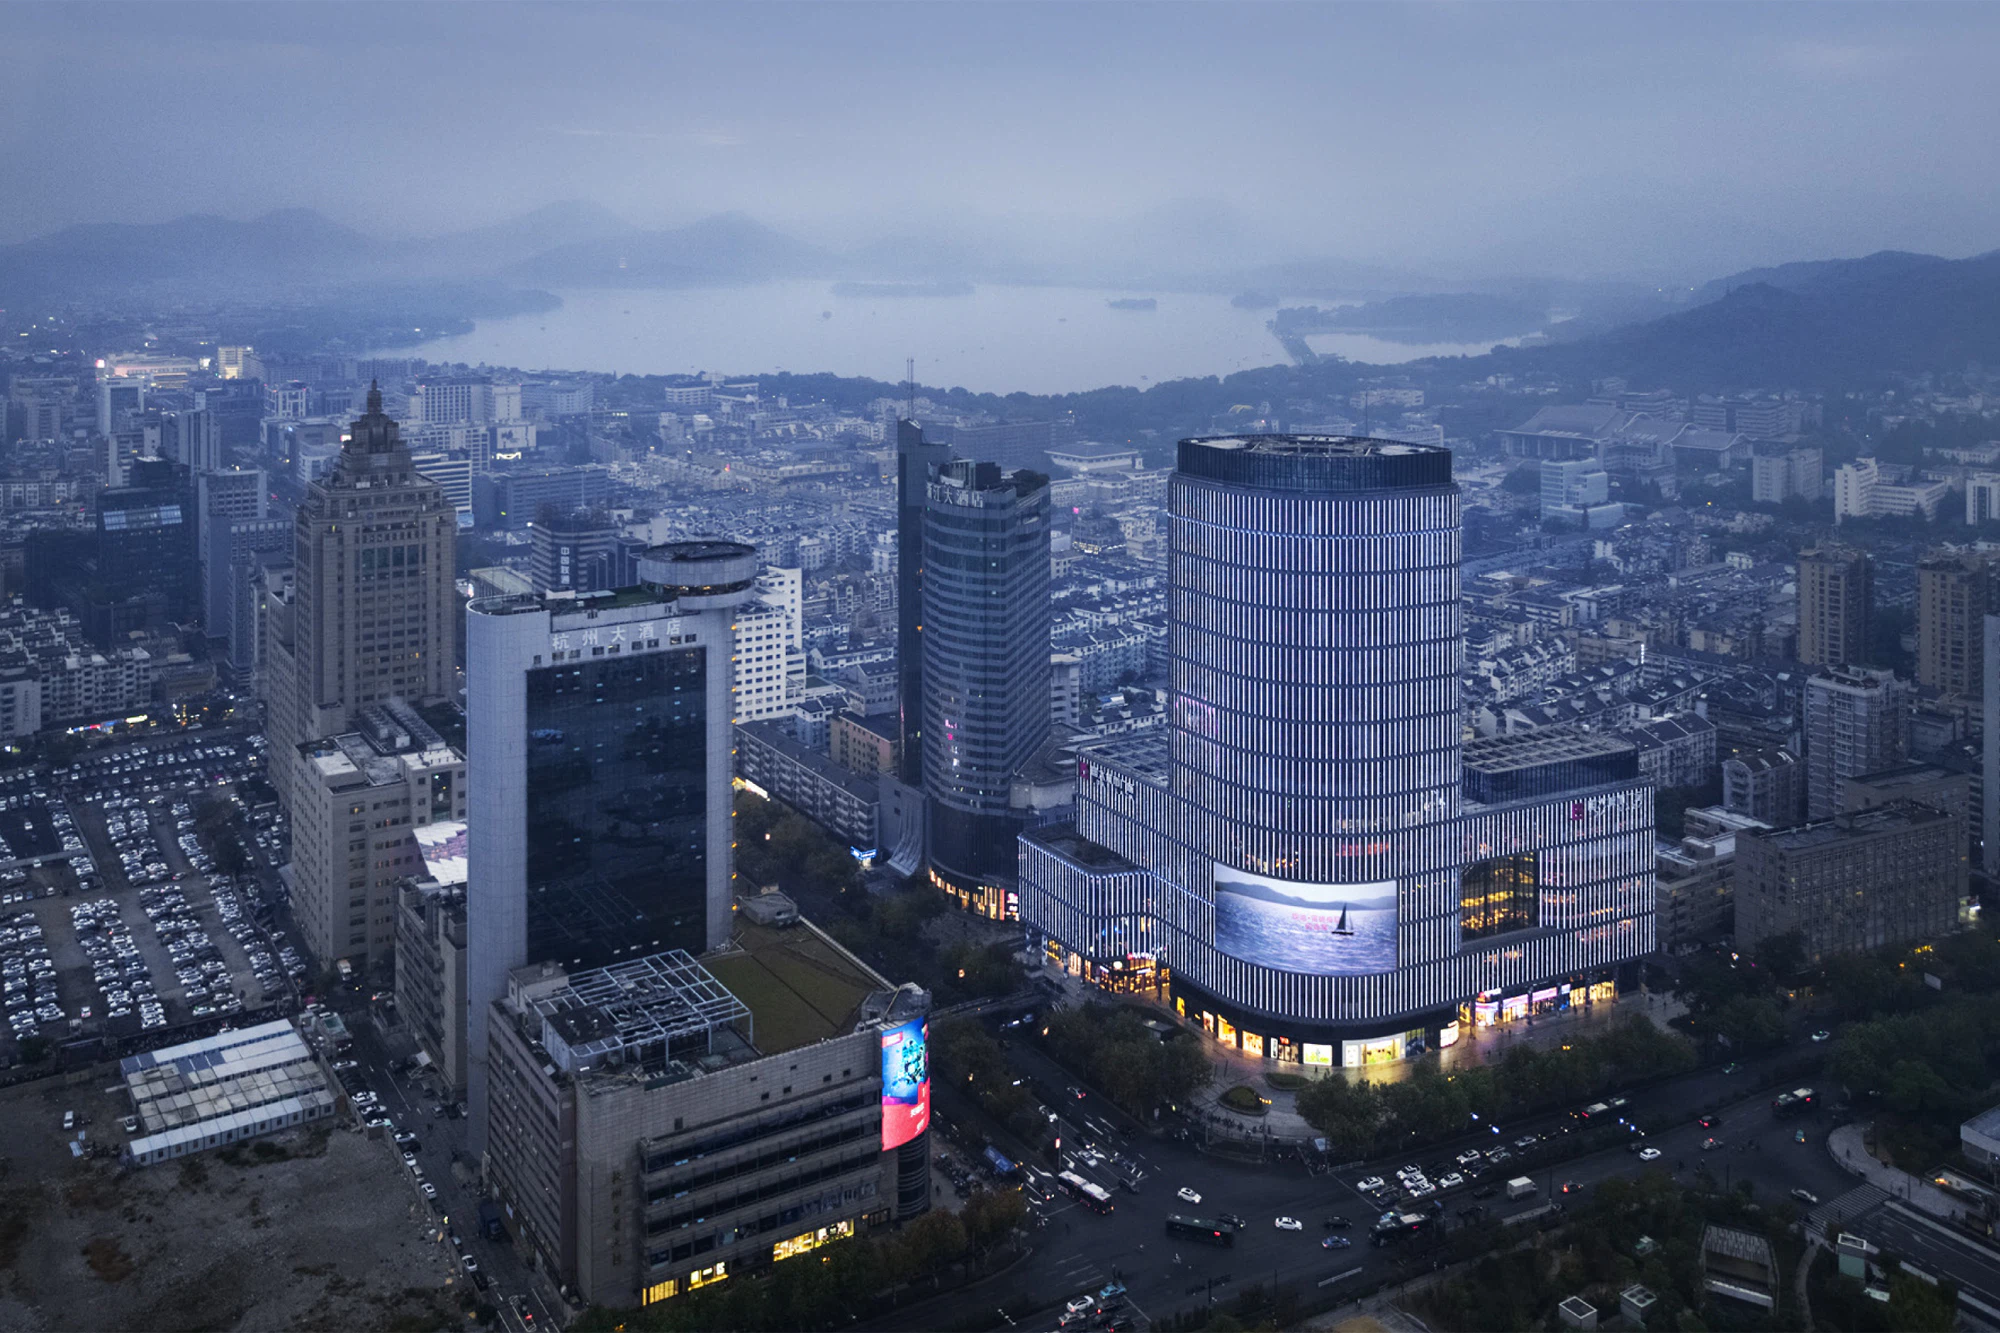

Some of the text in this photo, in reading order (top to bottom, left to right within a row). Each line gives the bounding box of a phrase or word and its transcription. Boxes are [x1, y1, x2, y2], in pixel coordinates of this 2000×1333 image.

[552, 620, 681, 650] 杭州大酒店
